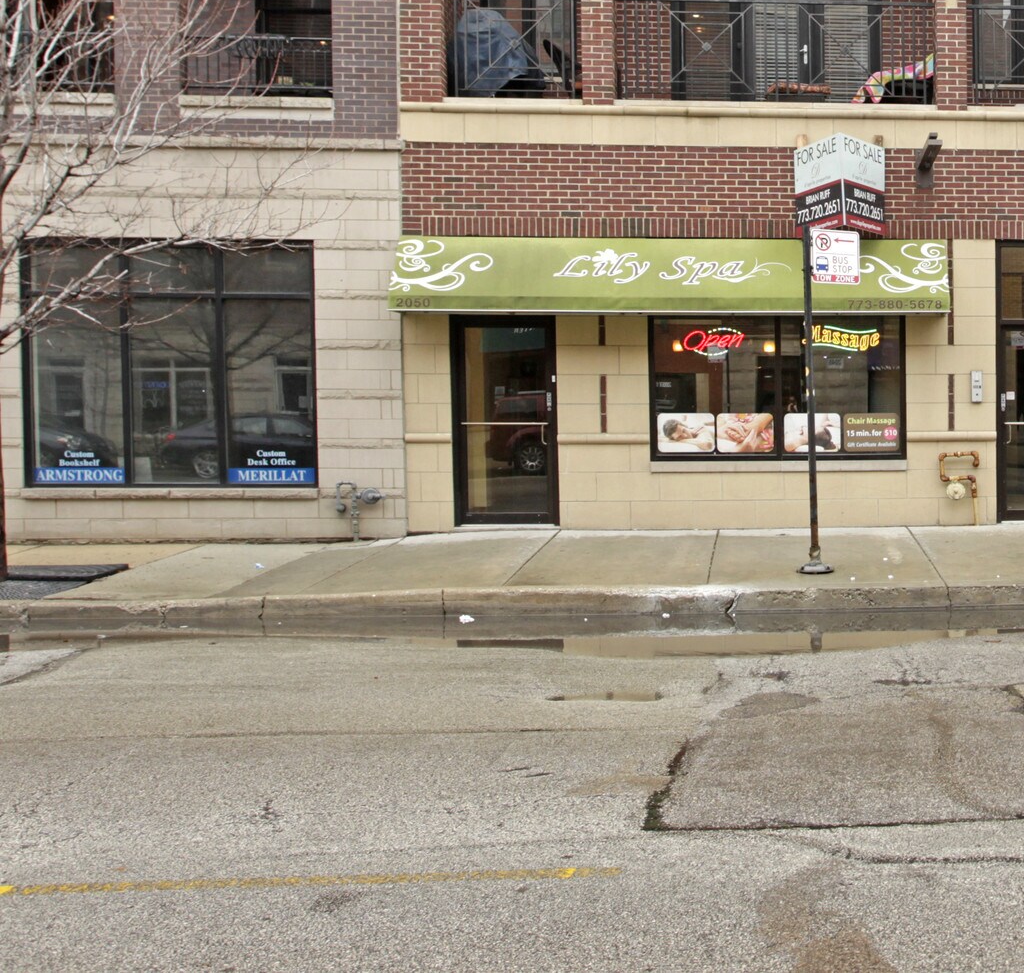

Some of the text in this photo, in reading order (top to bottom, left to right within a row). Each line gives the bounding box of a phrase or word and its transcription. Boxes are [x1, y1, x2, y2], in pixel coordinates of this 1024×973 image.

[796, 137, 837, 166] FOR SALE
[844, 137, 882, 164] FOR SALE
[805, 188, 831, 205] BRIAN RUFF
[853, 188, 876, 203] BRIAN RUFF
[797, 199, 841, 224] 773.720.2651
[846, 198, 884, 221] 773.720.2651
[832, 256, 849, 265] BUS
[554, 251, 748, 285] Lily Spa
[832, 265, 853, 274] STOP
[835, 275, 856, 283] ZONE
[395, 297, 431, 308] 2050
[848, 300, 943, 310] 773-880-5678
[683, 330, 746, 352] Open
[847, 417, 897, 426] Chair Massage
[847, 429, 855, 437] 15
[884, 429, 898, 437] $10
[64, 450, 94, 458] Custom
[256, 449, 286, 458] Custom
[58, 458, 100, 467] Bookshelf
[247, 458, 297, 466] Desk Office
[36, 469, 123, 482] ARMSTRONG
[238, 470, 306, 482] MERILLAT
